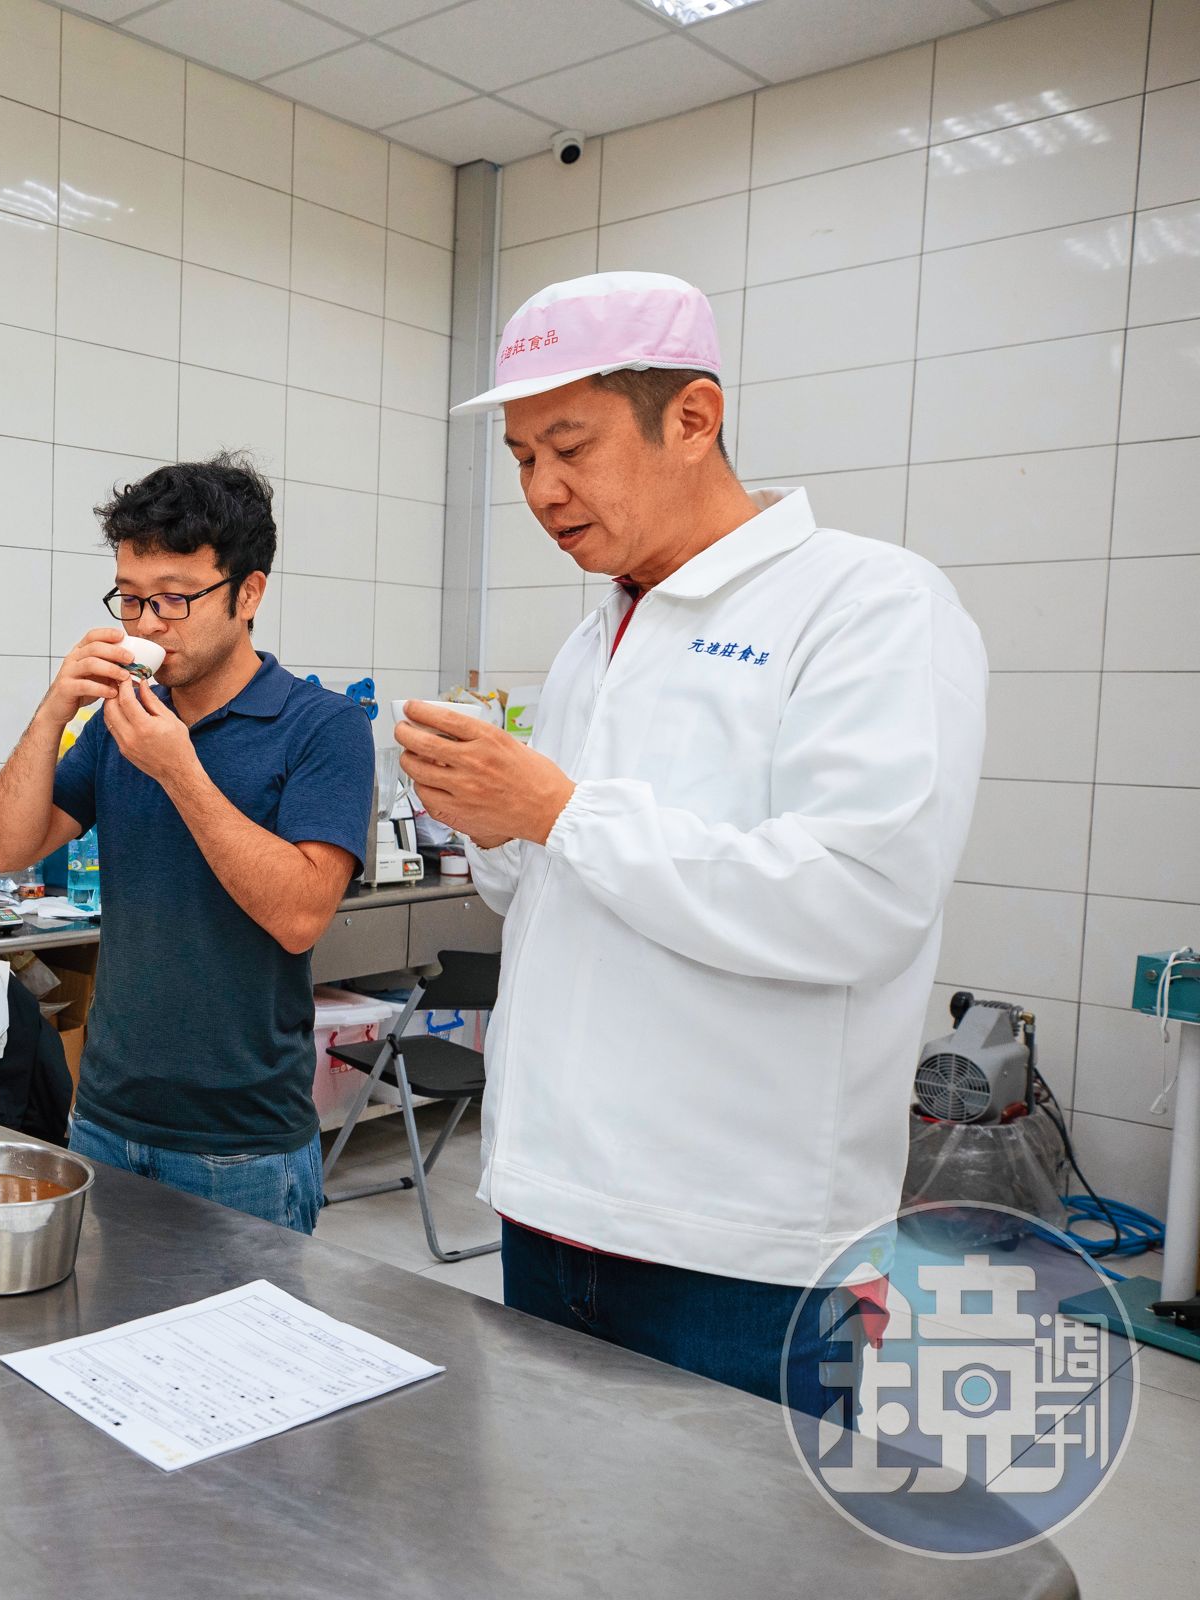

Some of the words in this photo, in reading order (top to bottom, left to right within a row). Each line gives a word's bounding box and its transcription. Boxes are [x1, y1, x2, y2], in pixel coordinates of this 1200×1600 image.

[687, 638, 770, 666] 元進莊食品
